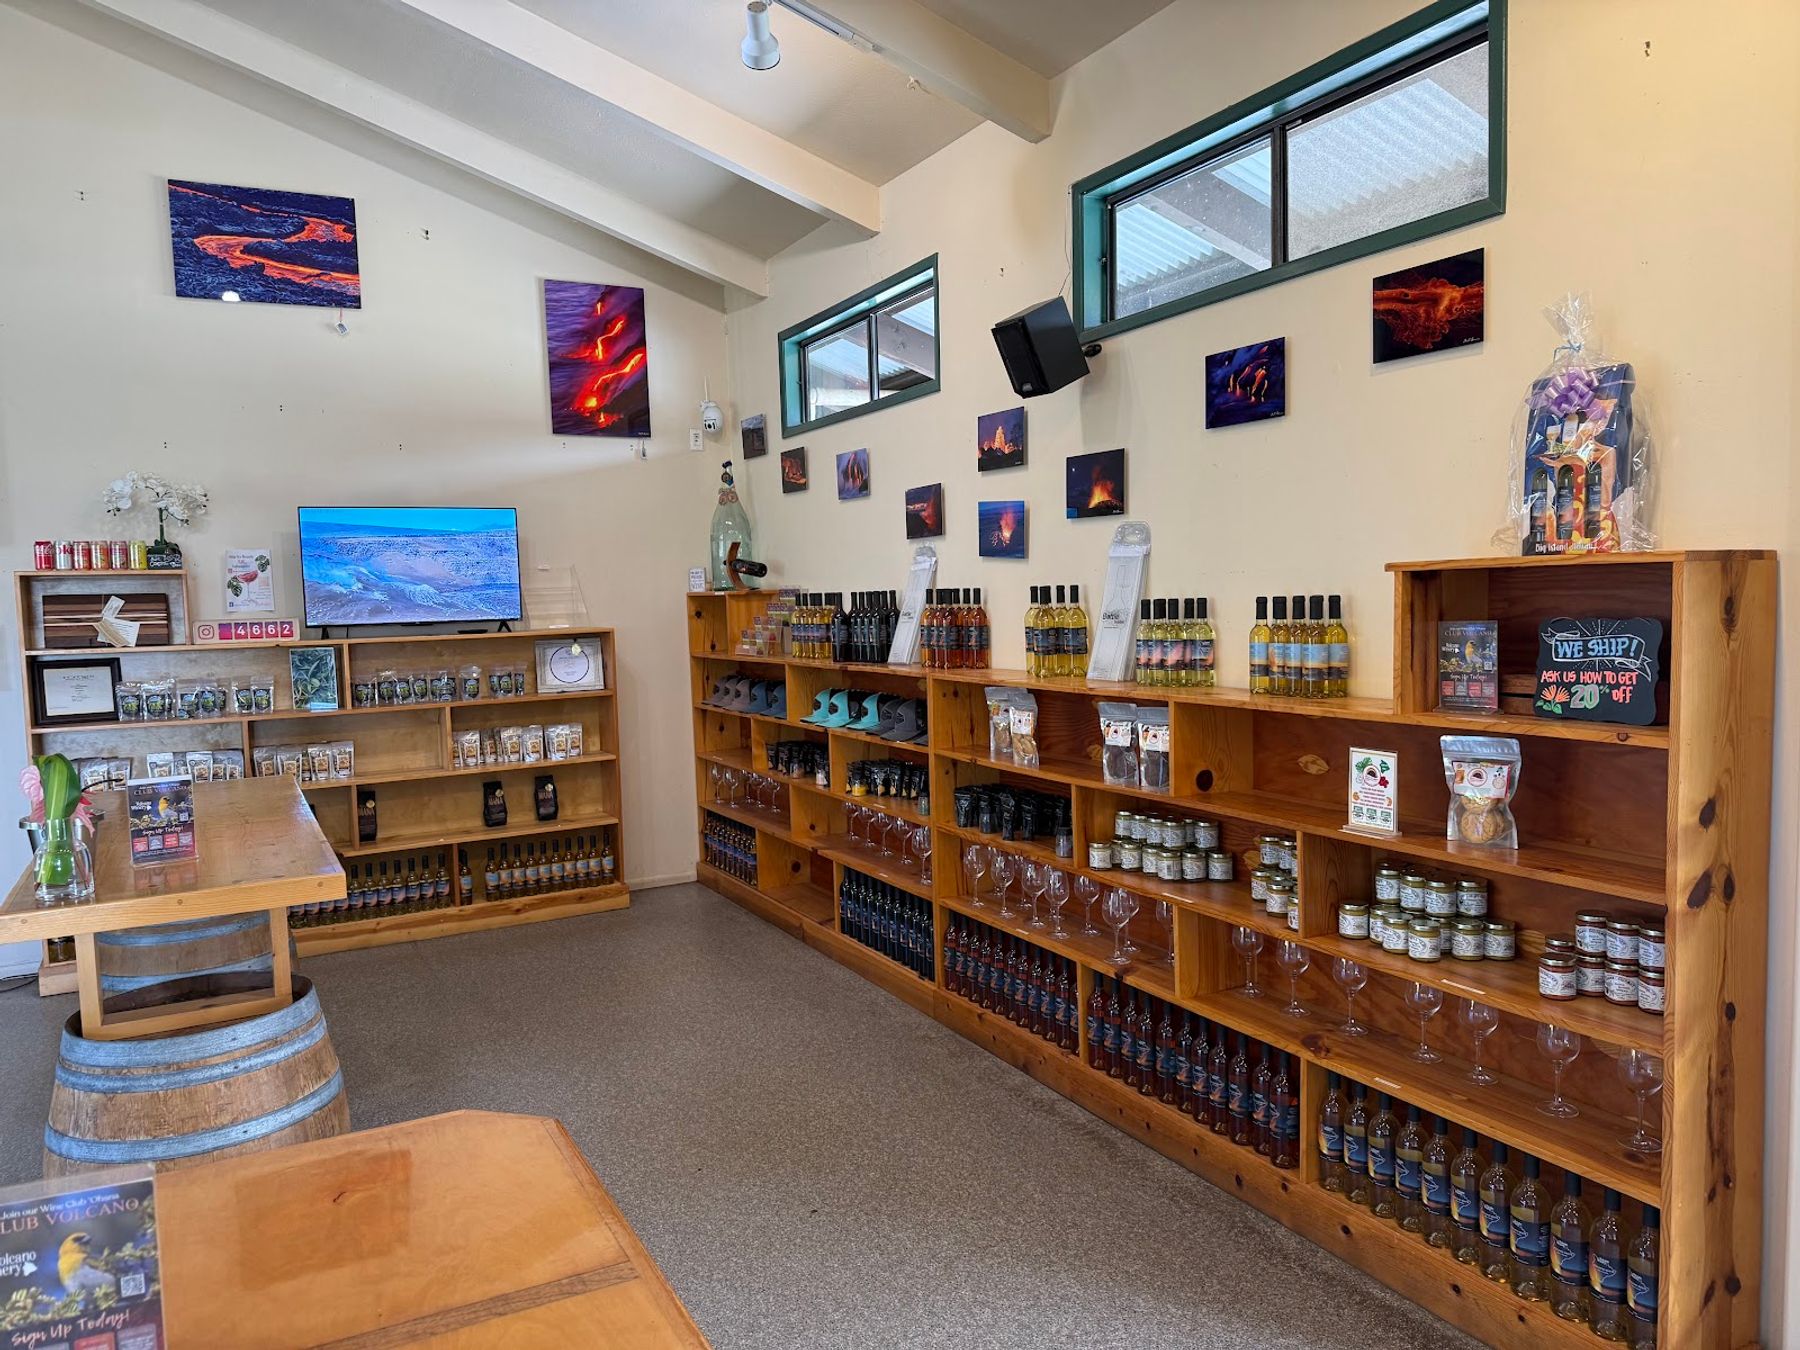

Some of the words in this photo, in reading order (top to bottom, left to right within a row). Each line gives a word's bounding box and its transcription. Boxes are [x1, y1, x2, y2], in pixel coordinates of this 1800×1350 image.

[1555, 641, 1583, 658] WE
[1587, 637, 1638, 657] SHIP!
[1540, 671, 1561, 683] ASK
[1563, 671, 1577, 682] US
[1580, 671, 1602, 685] HOW
[1604, 671, 1617, 685] TO
[1618, 671, 1639, 685] GET
[0, 1216, 39, 1235] LUB
[45, 1197, 140, 1226] VOLCANO
[1, 1210, 20, 1219] Join
[22, 1208, 38, 1216] our
[40, 1202, 63, 1212] Wine
[65, 1198, 87, 1208] Club
[0, 1251, 37, 1267] olcano
[11, 1329, 47, 1349] Sign
[76, 1308, 130, 1331] Today!
